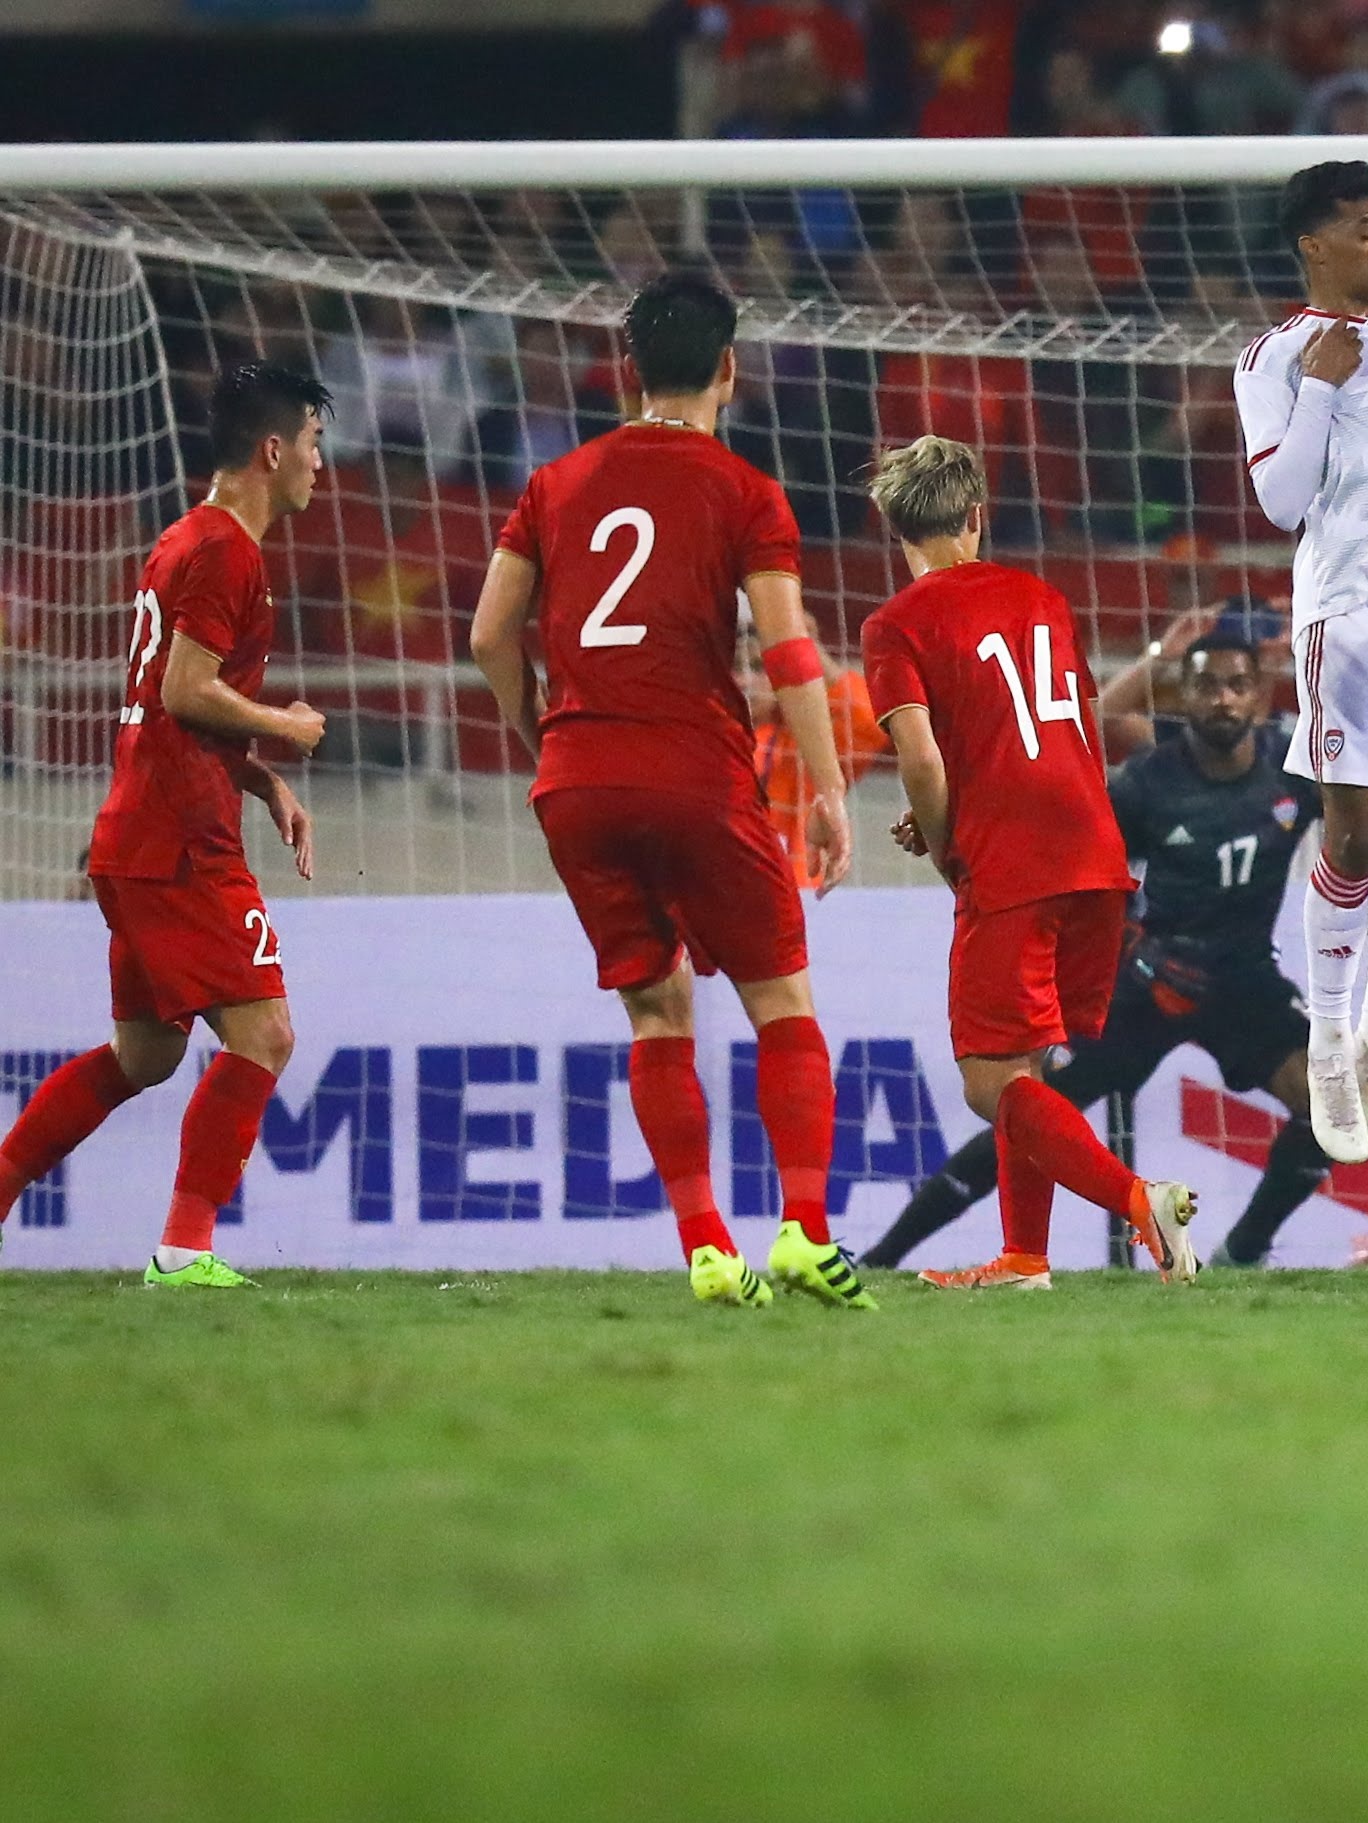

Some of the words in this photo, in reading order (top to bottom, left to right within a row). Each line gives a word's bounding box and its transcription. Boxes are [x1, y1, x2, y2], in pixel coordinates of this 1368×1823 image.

[579, 506, 656, 649] 2
[976, 624, 1092, 761] 14
[1216, 834, 1259, 889] 17
[244, 908, 282, 967] 2
[198, 1038, 948, 1225] MEDIA
